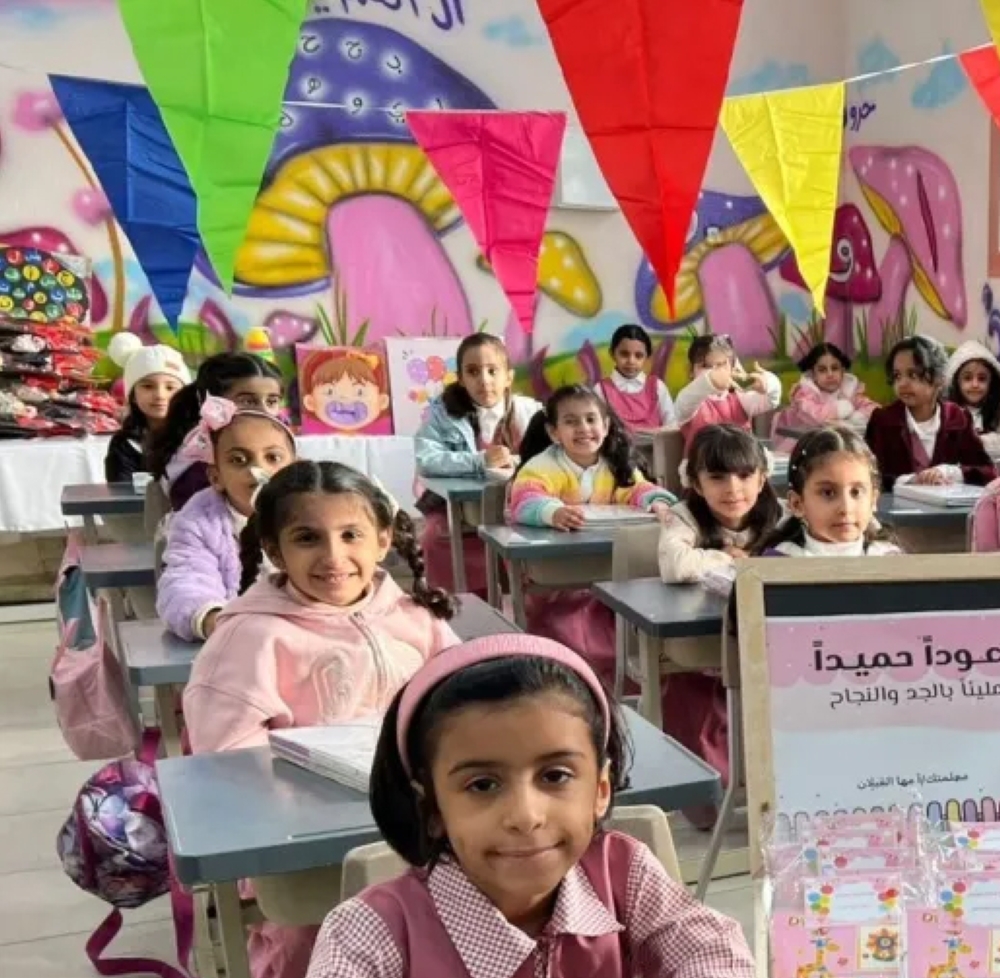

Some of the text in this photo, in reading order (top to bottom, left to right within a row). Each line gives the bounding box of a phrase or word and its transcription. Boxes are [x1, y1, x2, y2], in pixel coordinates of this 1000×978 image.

[842, 101, 877, 132] حرو
[830, 685, 899, 710] والنجاح
[907, 683, 954, 702] بالجد
